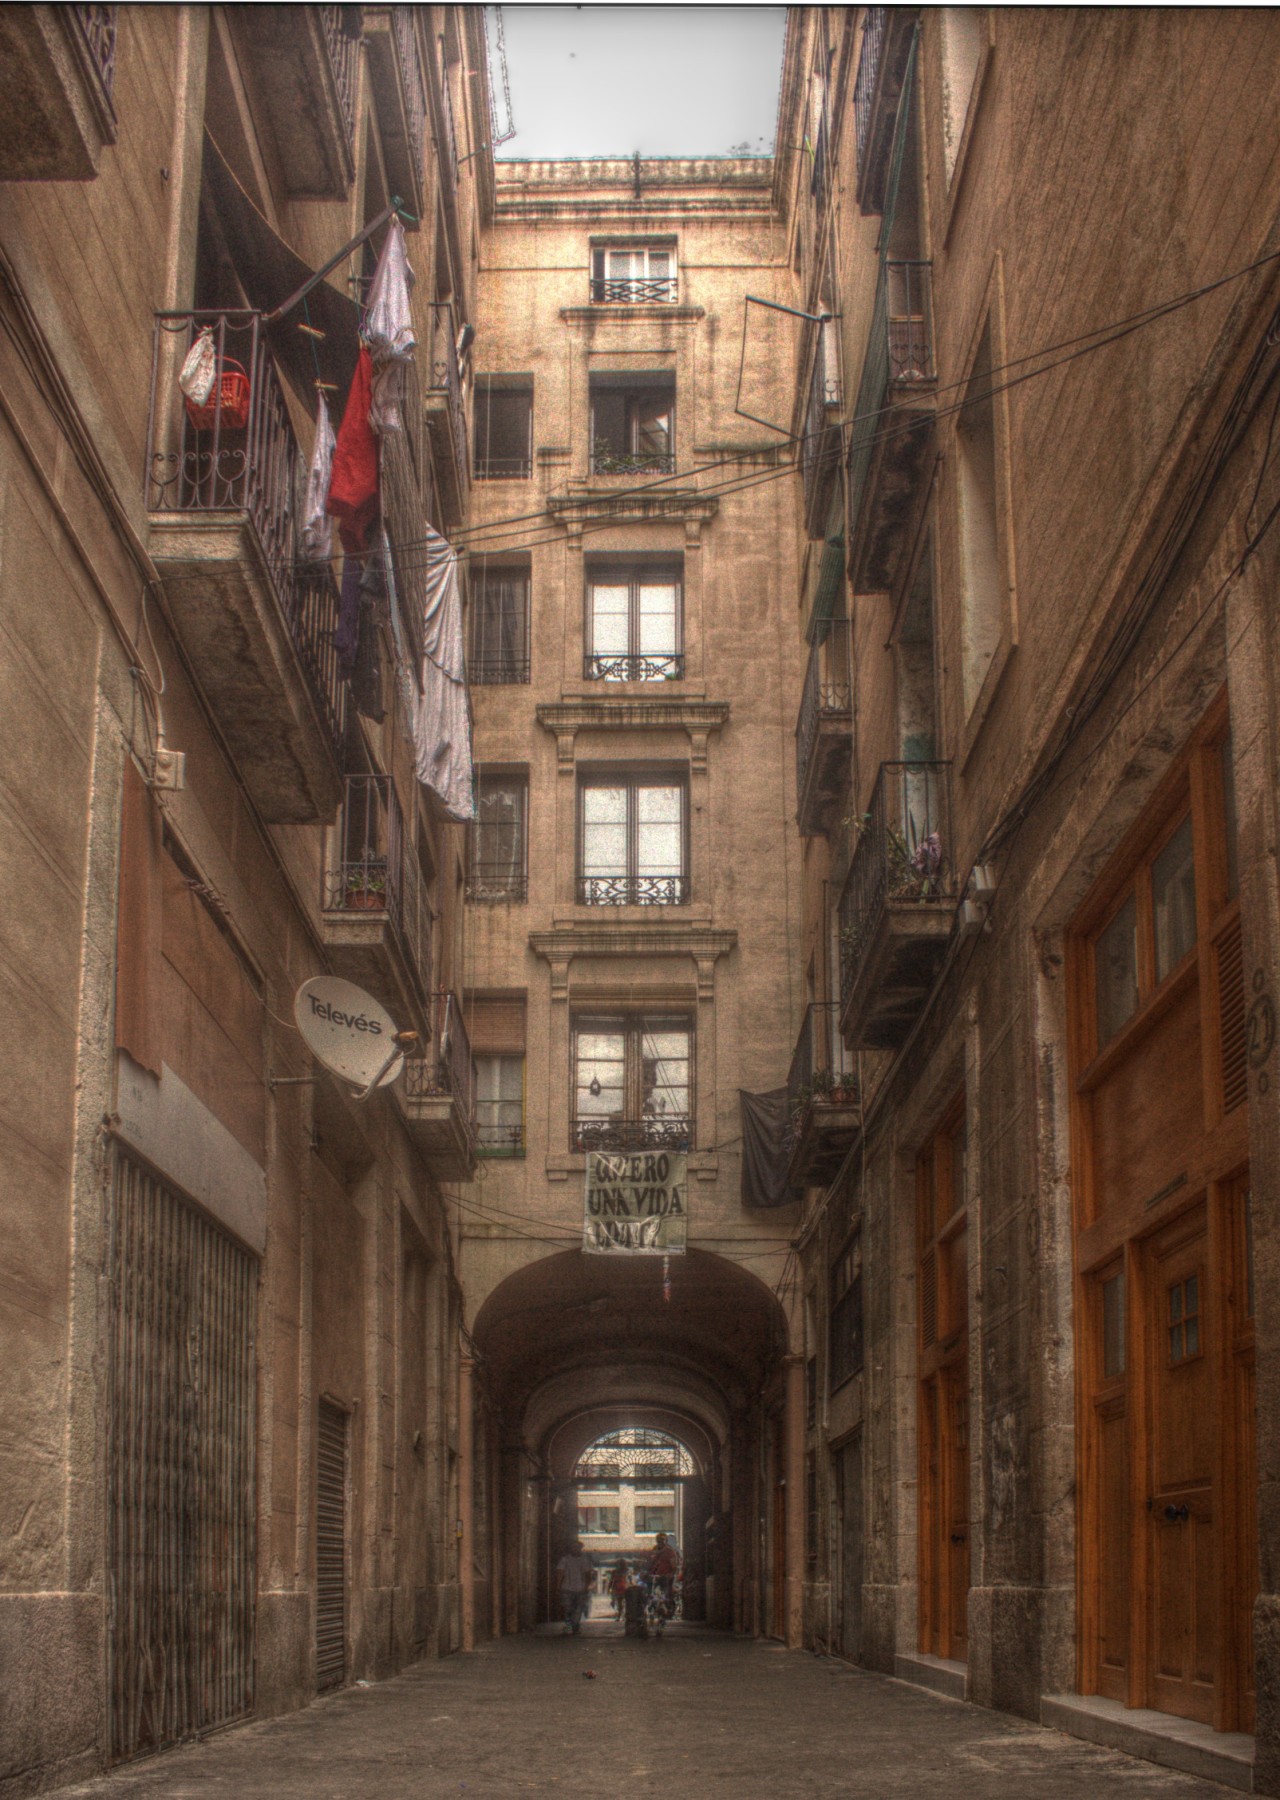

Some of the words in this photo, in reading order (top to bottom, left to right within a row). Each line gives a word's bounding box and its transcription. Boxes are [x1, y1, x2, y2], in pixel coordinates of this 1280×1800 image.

[307, 993, 382, 1035] Televés
[588, 1188, 630, 1216] UNA
[632, 1187, 683, 1216] VIDA
